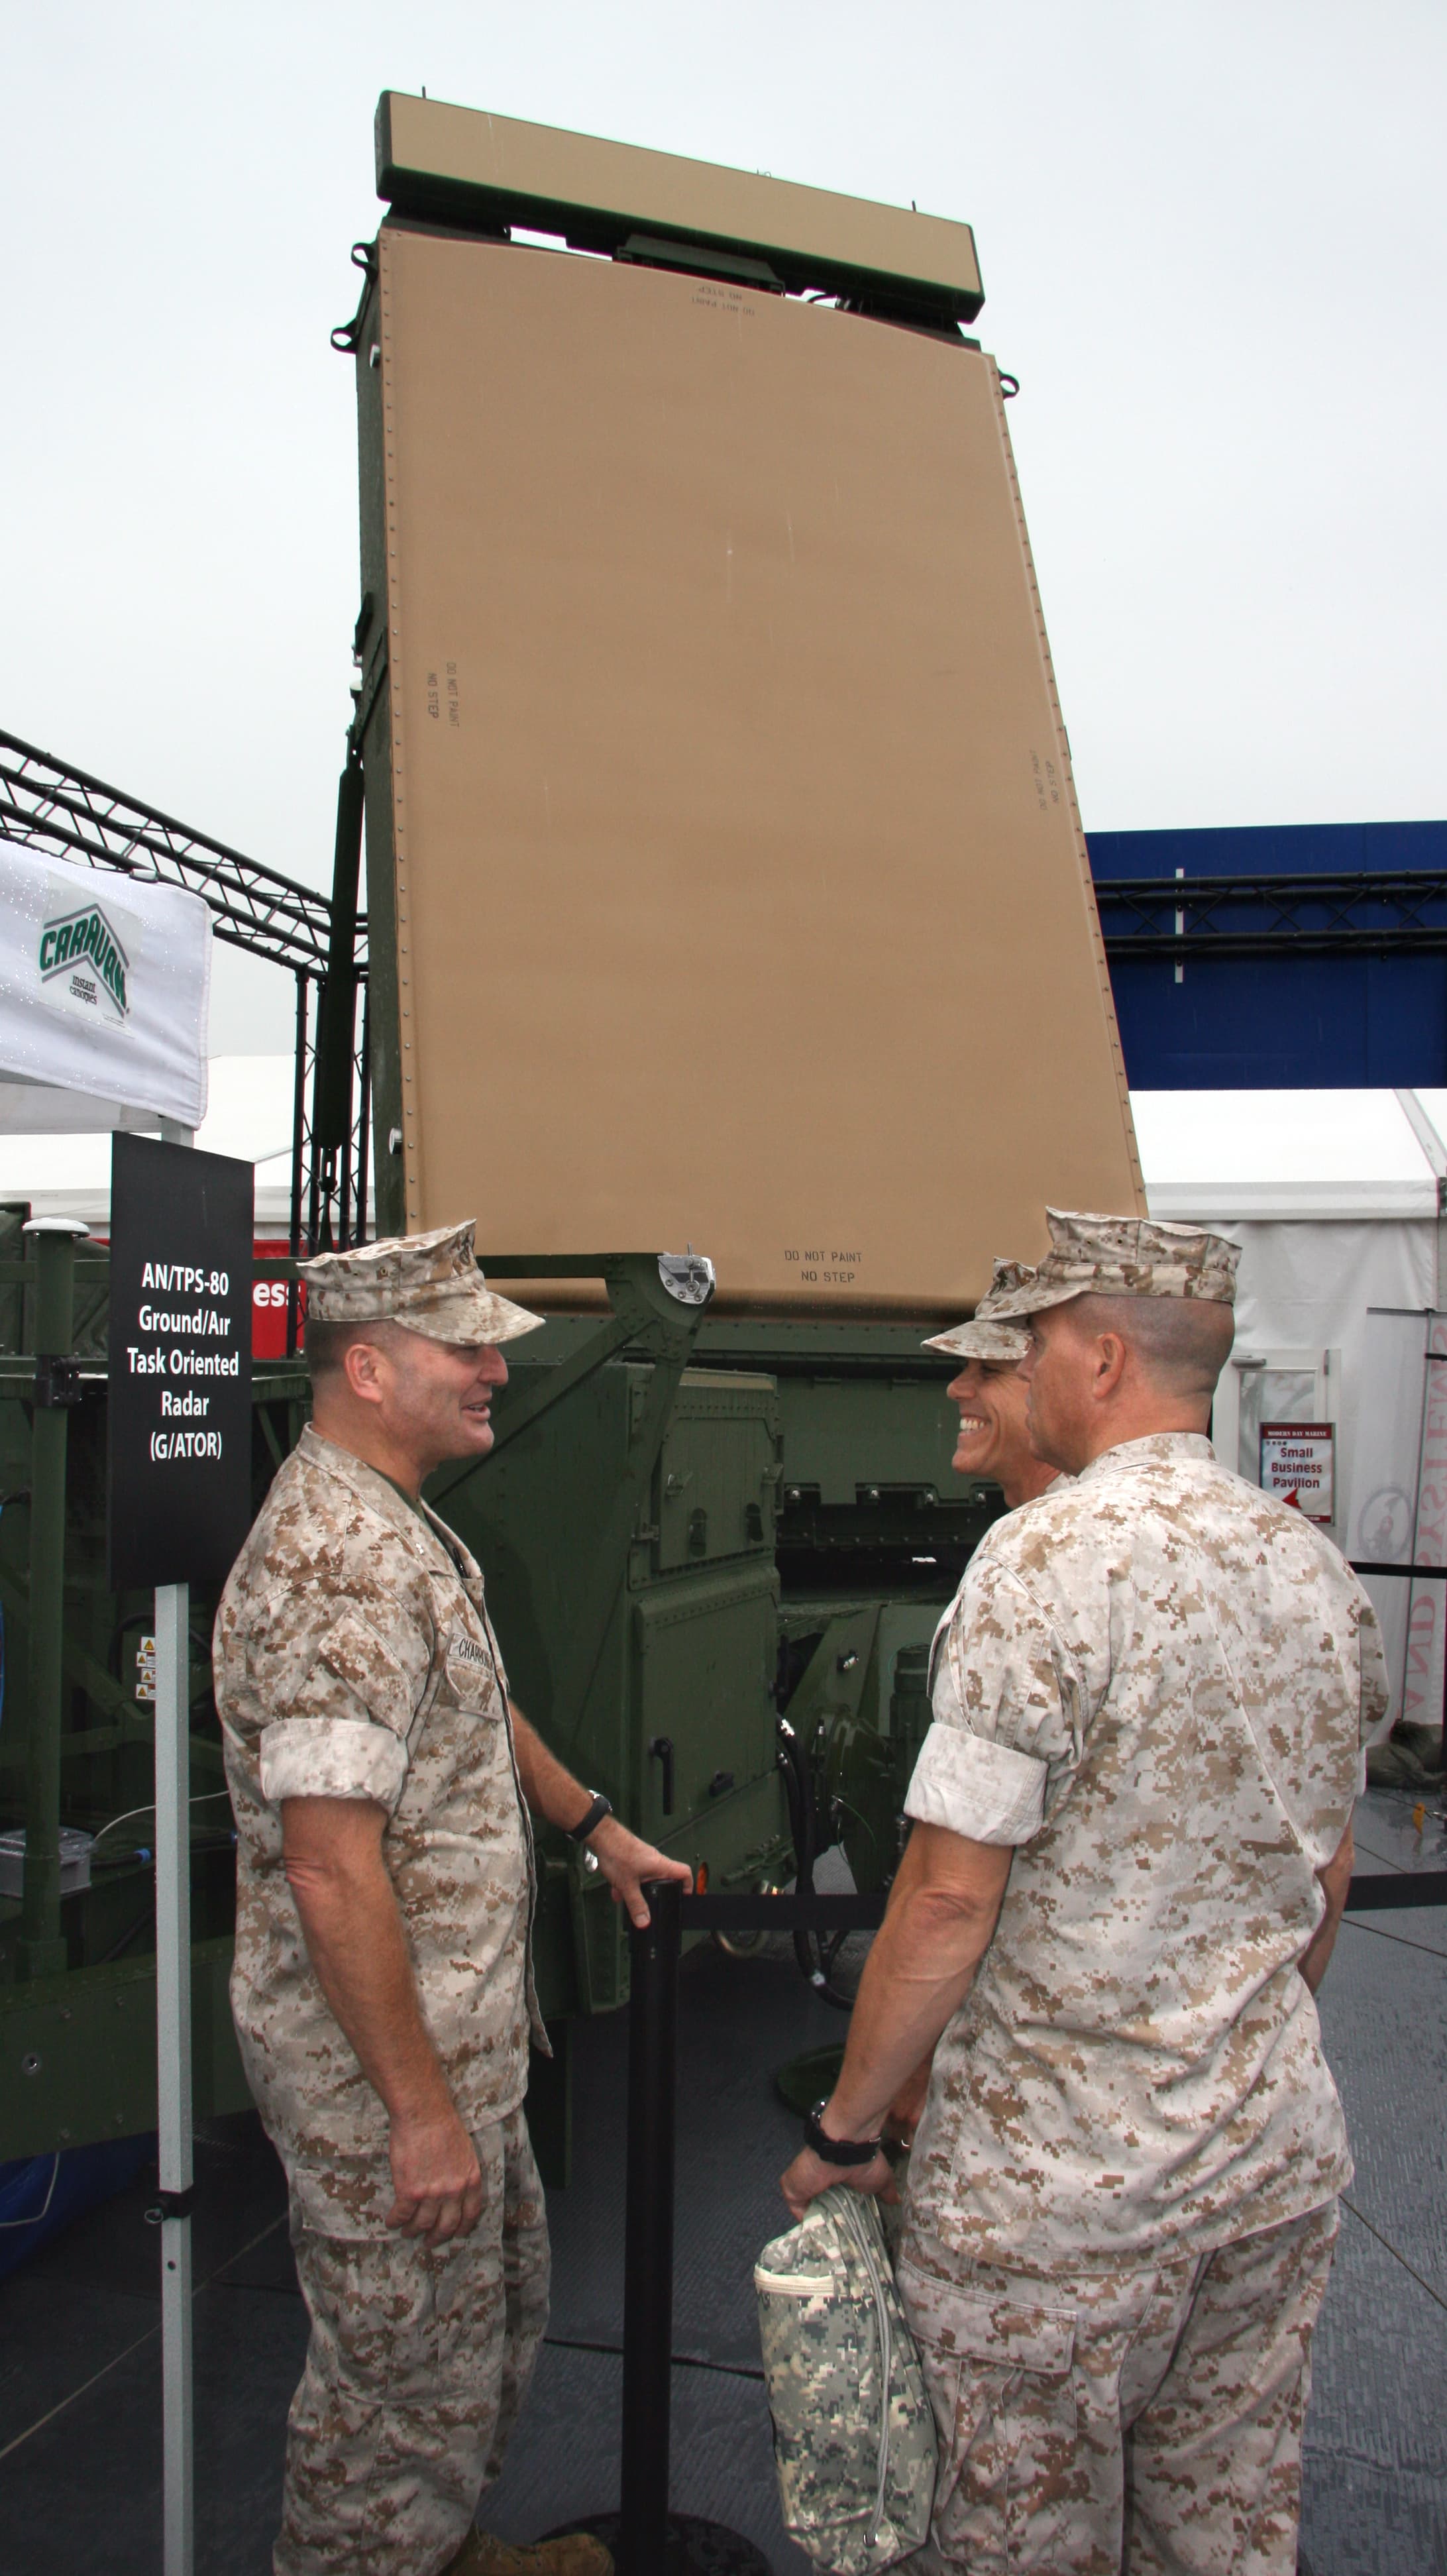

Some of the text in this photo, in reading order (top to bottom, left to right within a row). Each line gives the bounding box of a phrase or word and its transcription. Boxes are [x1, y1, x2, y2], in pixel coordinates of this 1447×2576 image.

[428, 672, 439, 718] NO STEP
[447, 662, 460, 727] DO NOT PAINT
[40, 913, 127, 1009] CARAVAN
[70, 986, 97, 1005] canopies
[72, 975, 96, 993] instant
[784, 1250, 862, 1262] DO NOT PAINT
[141, 1262, 229, 1296] AN/TPS-80
[801, 1271, 855, 1283] NO STEP
[139, 1305, 231, 1336] Ground/Air
[127, 1347, 239, 1376] Task Oriented
[162, 1390, 209, 1416] Radar
[150, 1431, 222, 1462] (G/ATOR)
[1281, 1448, 1313, 1458] Small
[1271, 1462, 1322, 1474] Business
[1273, 1477, 1320, 1488] Pavilion
